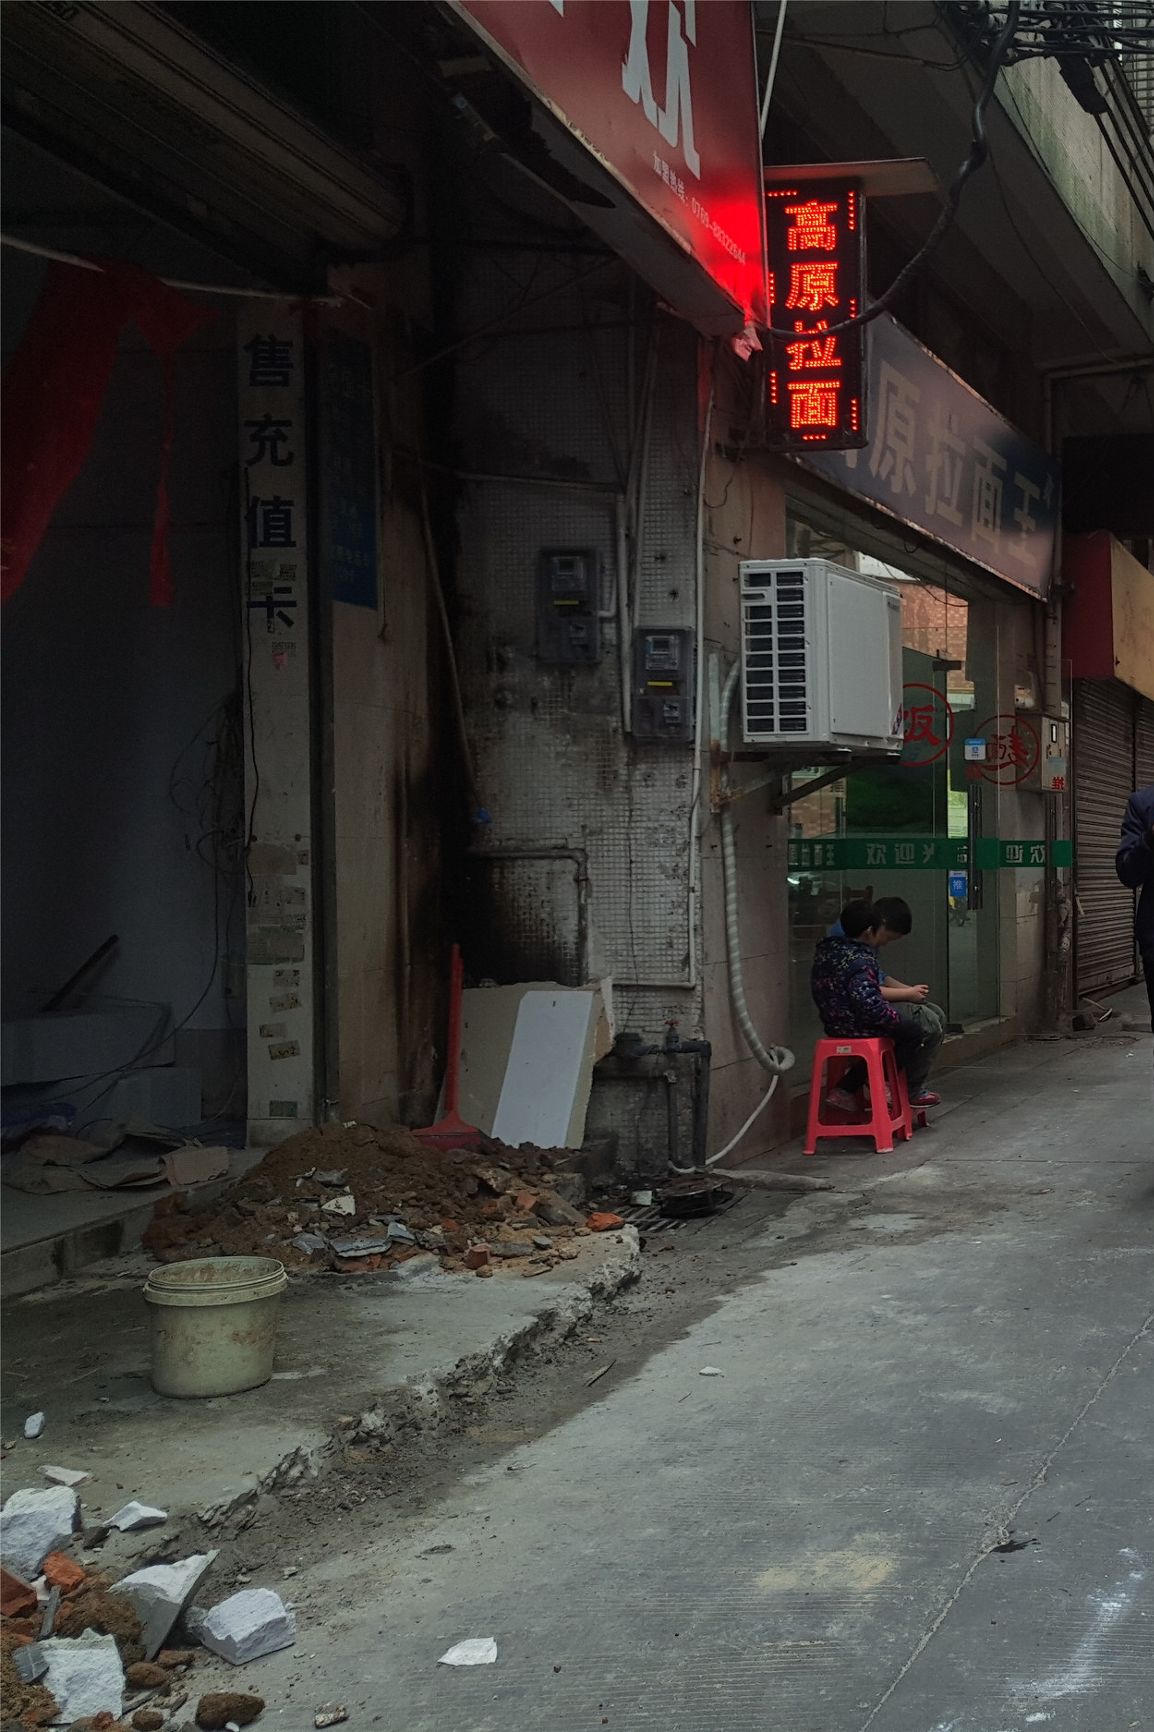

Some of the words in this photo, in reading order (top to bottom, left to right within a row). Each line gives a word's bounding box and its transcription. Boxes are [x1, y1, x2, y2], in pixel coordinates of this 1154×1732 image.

[784, 199, 842, 430] 高原拉面
[244, 333, 297, 633] 售充值卡
[842, 360, 1039, 564] 原拉面王
